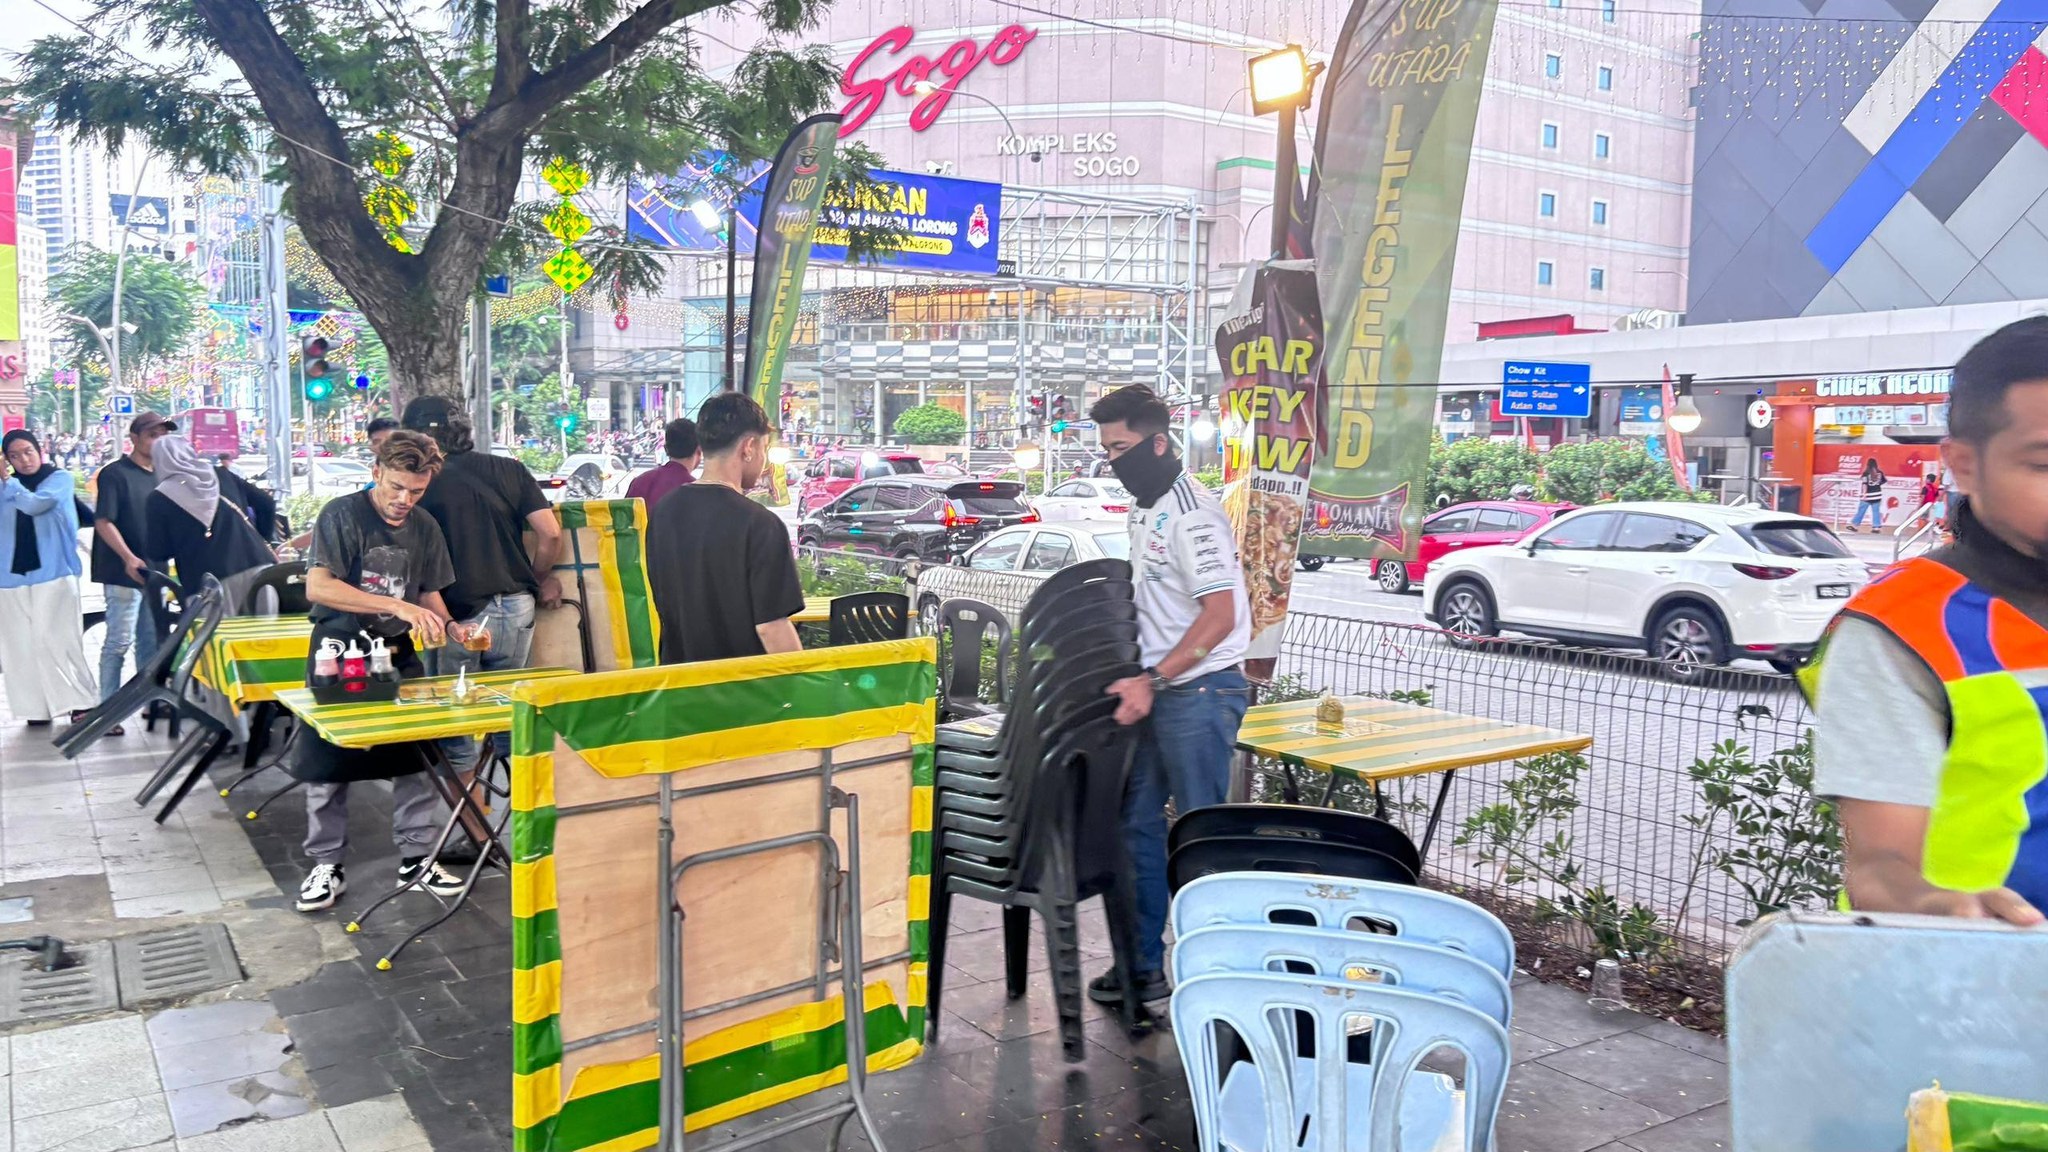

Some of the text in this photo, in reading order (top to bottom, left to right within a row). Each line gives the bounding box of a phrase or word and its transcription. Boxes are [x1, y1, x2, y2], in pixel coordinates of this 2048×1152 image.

[837, 24, 1039, 138] Sogo
[1367, 41, 1472, 88] UTARA
[997, 132, 1117, 156] KOMPLEKS
[1073, 157, 1140, 178] SOGO
[785, 176, 817, 203] SUP
[912, 218, 958, 237] LORONG
[1334, 104, 1412, 469] LEGEND
[1229, 385, 1307, 424] KEY
[1226, 434, 1309, 473] TW
